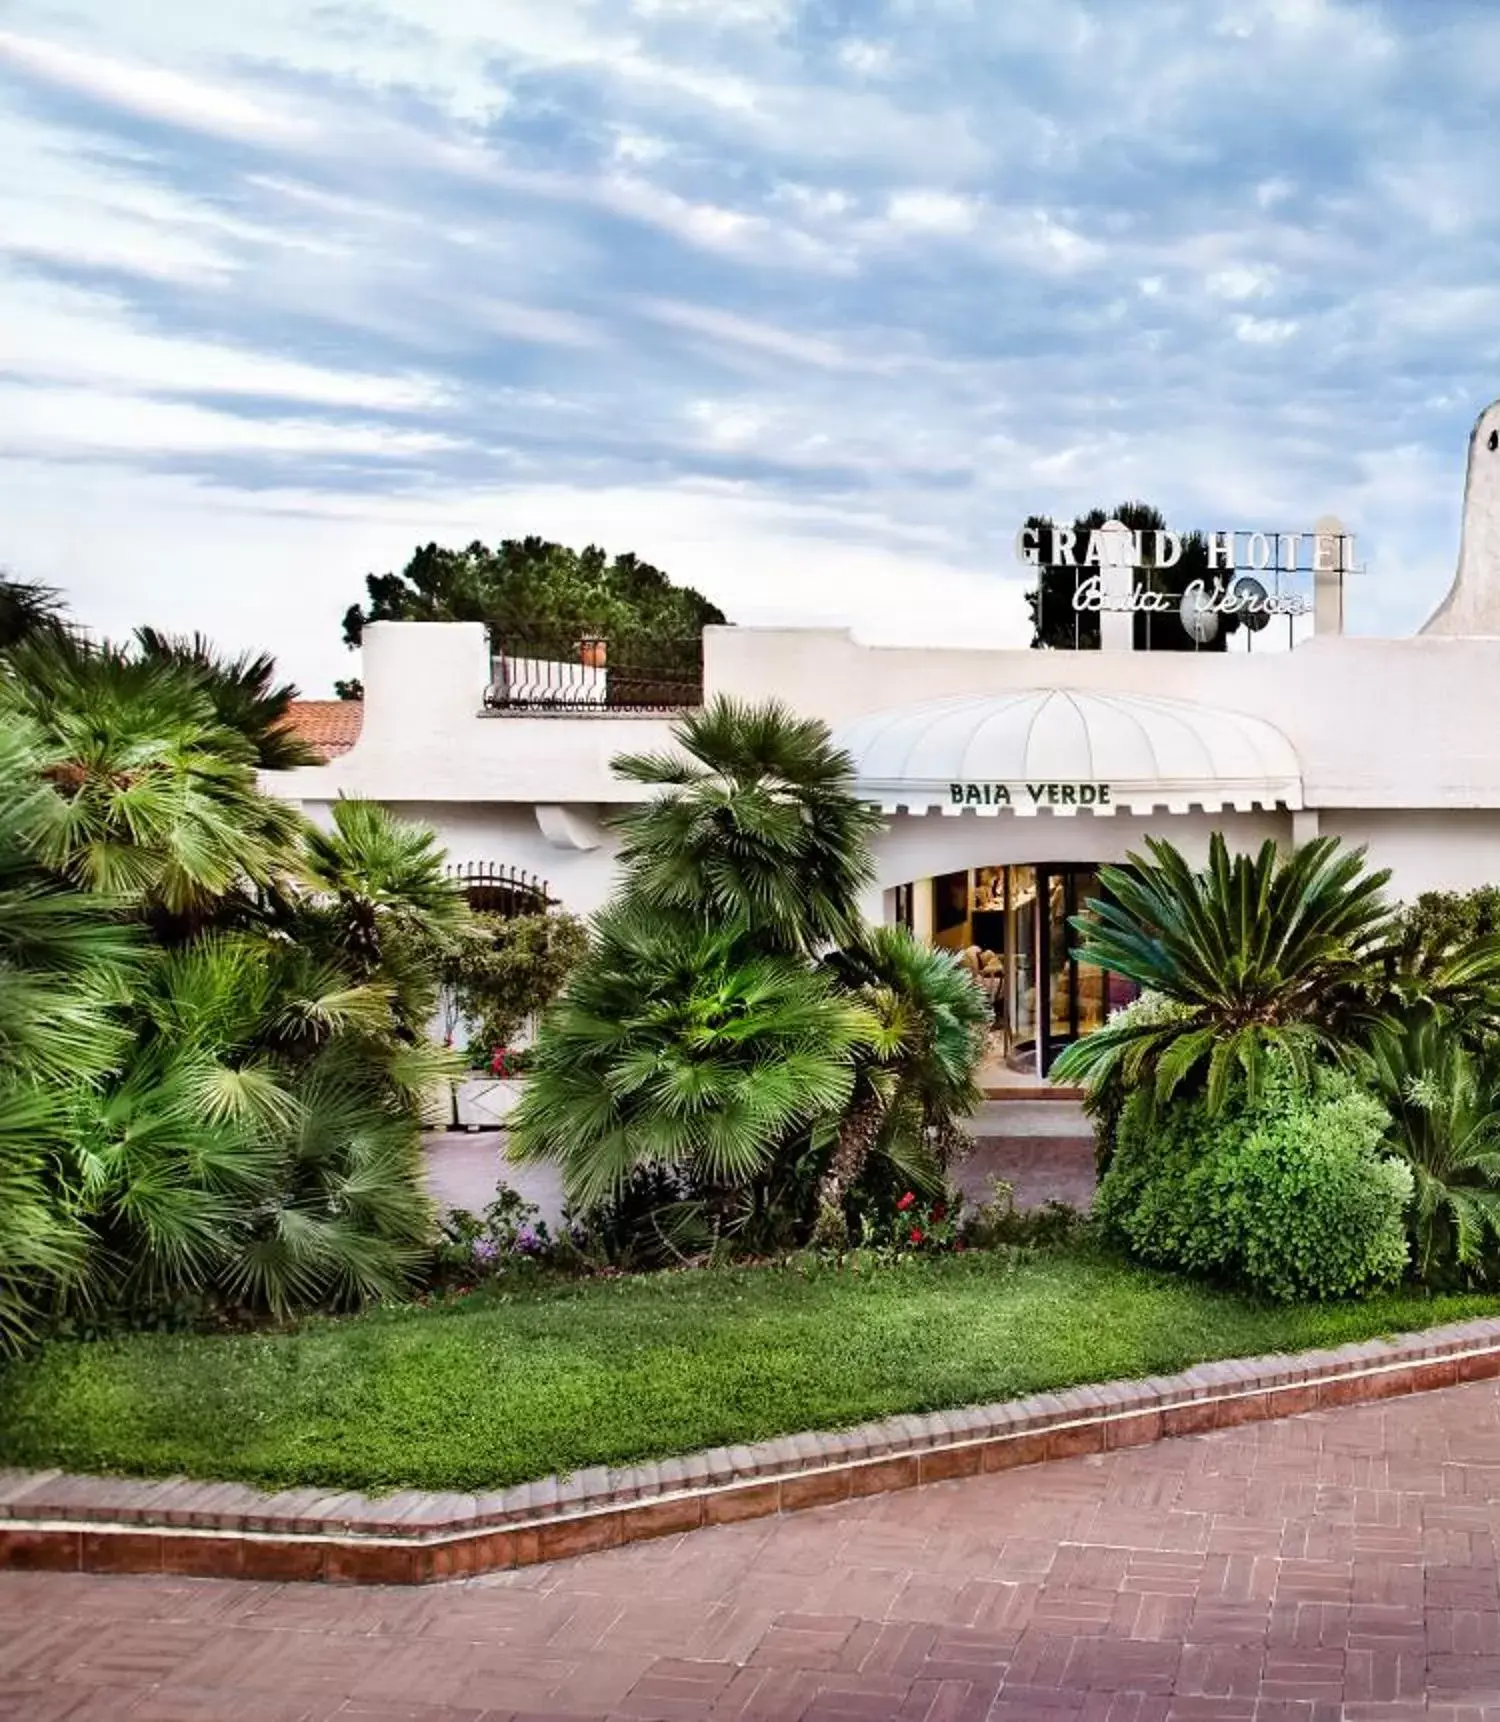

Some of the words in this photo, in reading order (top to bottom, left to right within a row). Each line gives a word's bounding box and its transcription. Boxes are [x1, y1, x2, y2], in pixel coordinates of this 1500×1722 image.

[1016, 527, 1183, 568] GRAND
[1207, 531, 1366, 573] HOTEL
[1072, 575, 1170, 611] Bia
[1184, 576, 1310, 614] Ver
[950, 784, 1011, 804] BAIA
[1026, 784, 1111, 804] VERDE
